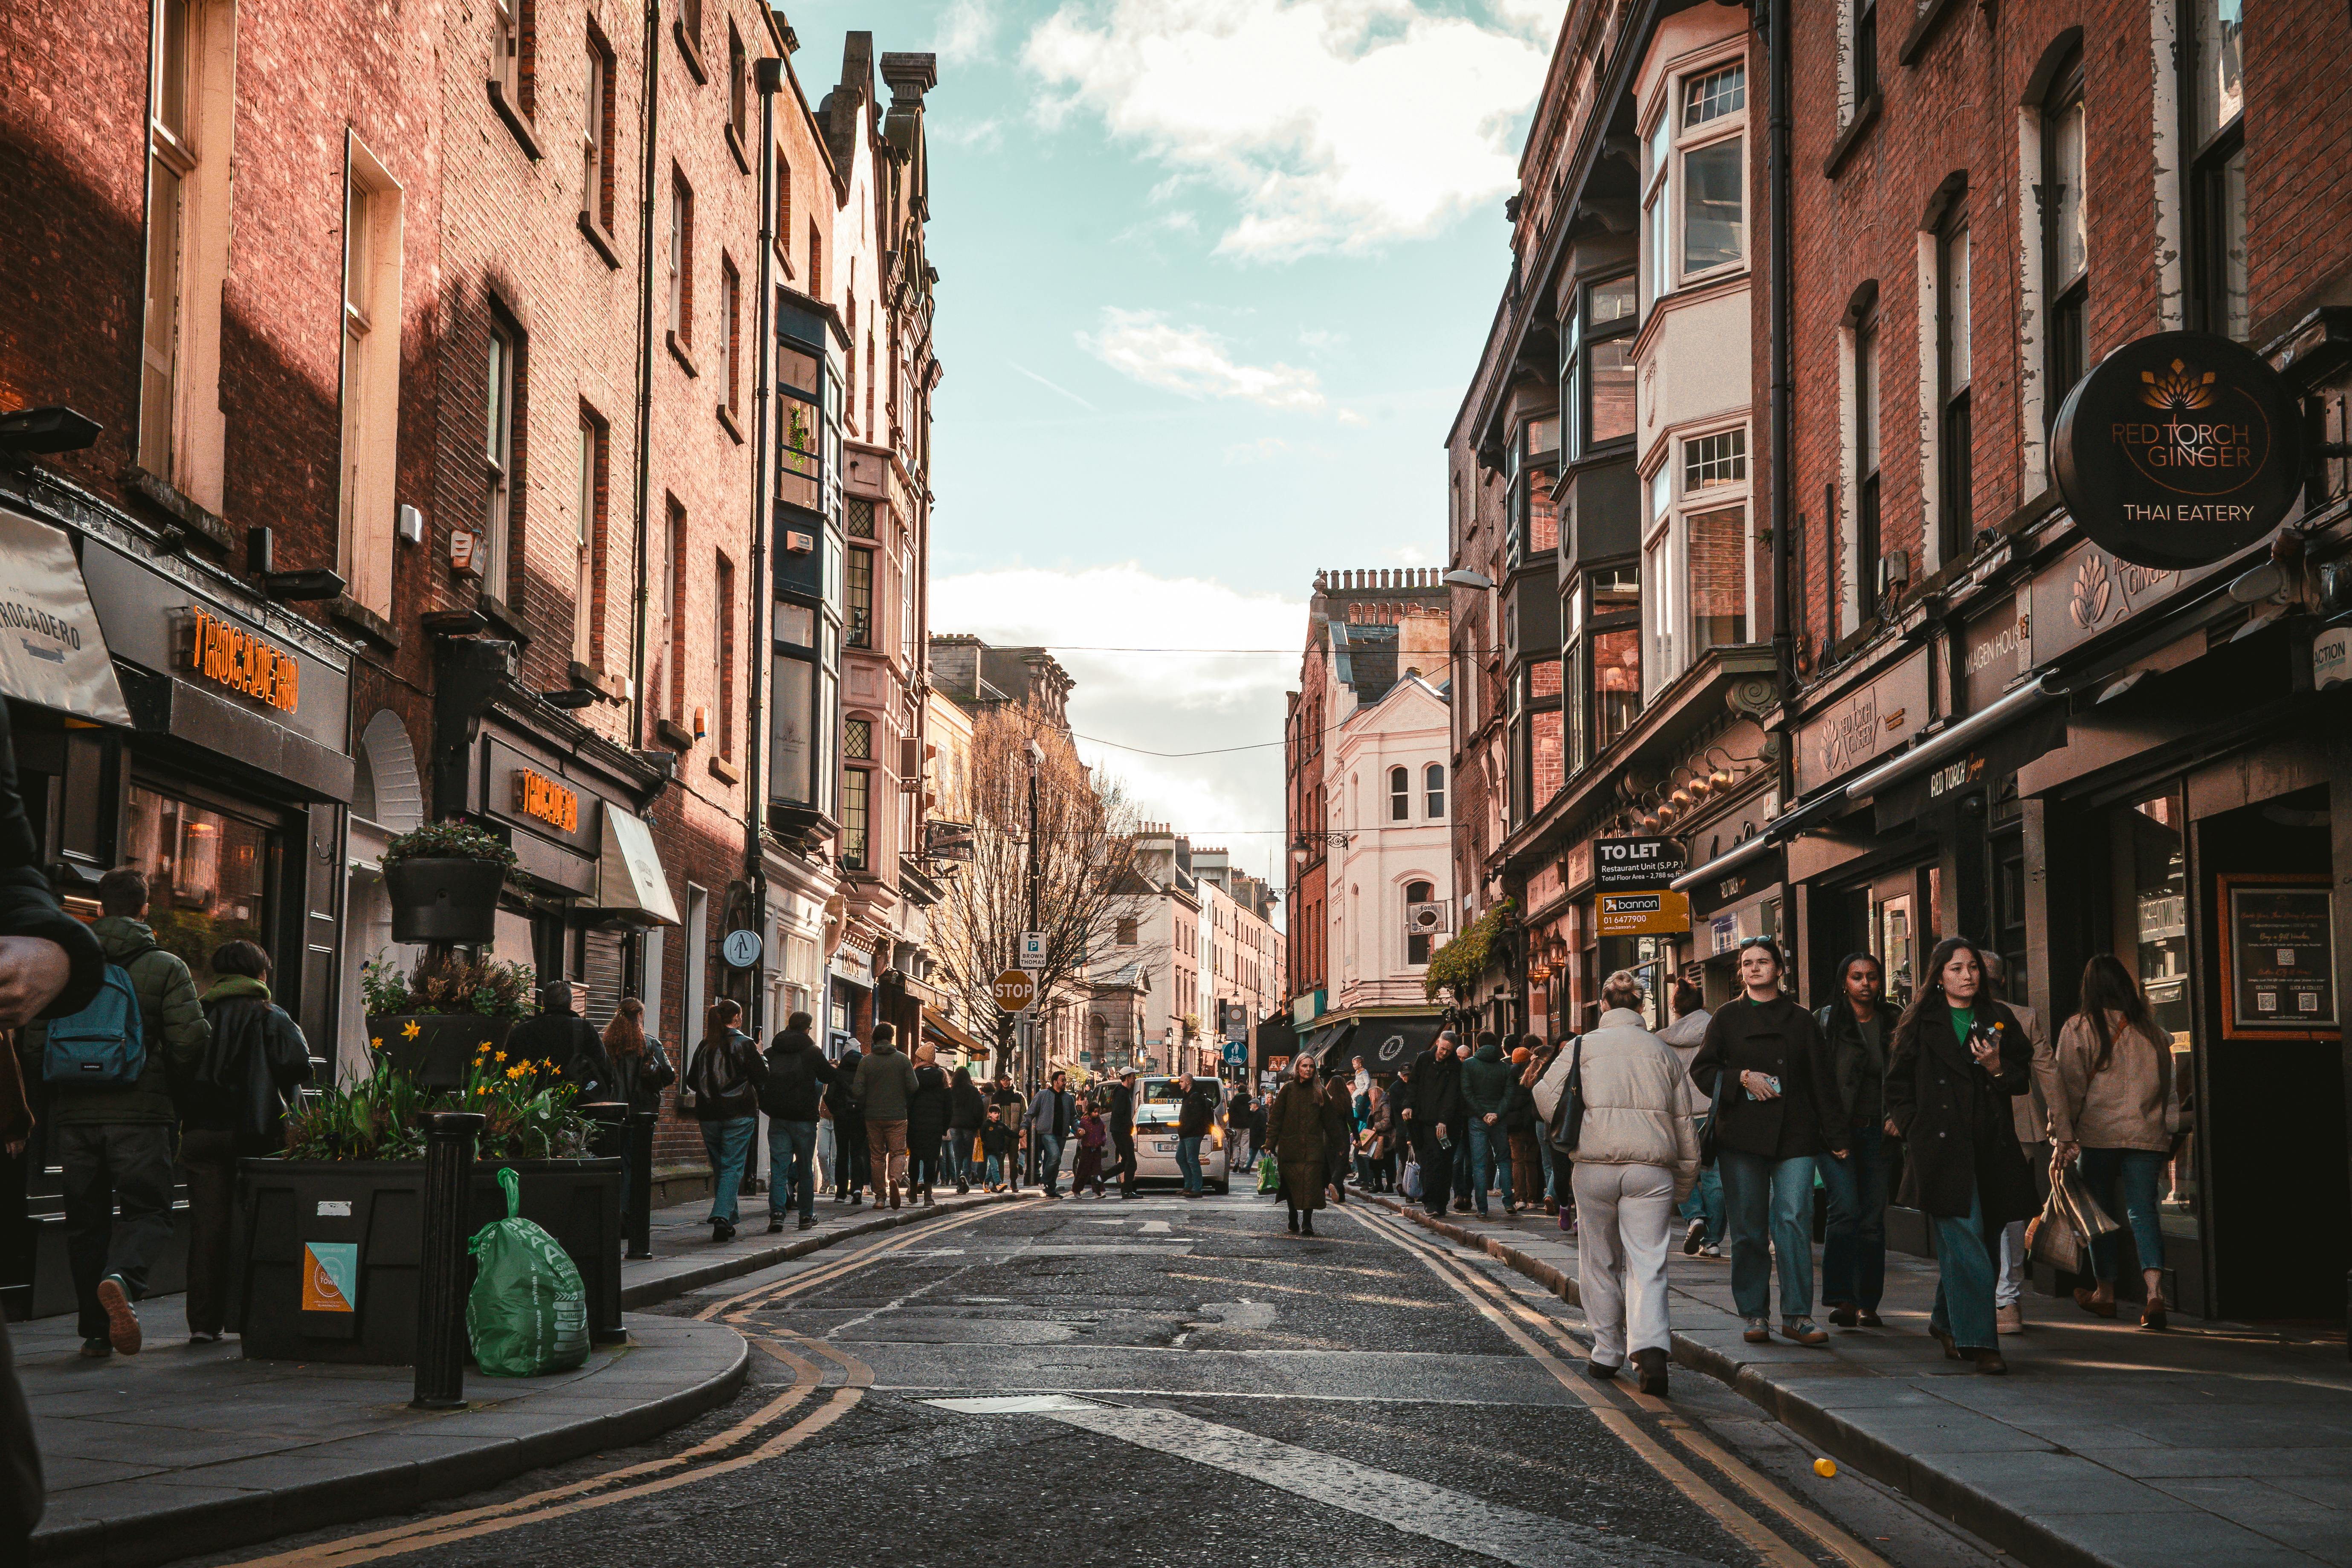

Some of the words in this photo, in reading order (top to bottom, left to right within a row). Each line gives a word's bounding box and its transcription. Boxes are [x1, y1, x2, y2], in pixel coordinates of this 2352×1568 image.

[2113, 423, 2159, 444] RED
[2163, 414, 2248, 445] TORCH
[2148, 446, 2251, 467] GINGER
[2123, 504, 2170, 521] THAI
[2178, 505, 2255, 522] EATERY
[0, 602, 81, 651] ROCADERO
[194, 605, 299, 715] TROCADERO
[1931, 771, 1944, 797] RED
[1944, 759, 1966, 791] TORCH
[523, 766, 578, 834] TROCADERO
[1601, 845, 1626, 860] TO
[1630, 843, 1661, 858] LET
[1602, 864, 1639, 872] Restaurant
[1657, 861, 1683, 871] (S.P.P.)
[1619, 900, 1657, 909] bannon
[1614, 915, 1646, 924] 6477900
[1030, 942, 1037, 951] P
[994, 983, 1032, 998] STOP
[1385, 1042, 1396, 1053] L
